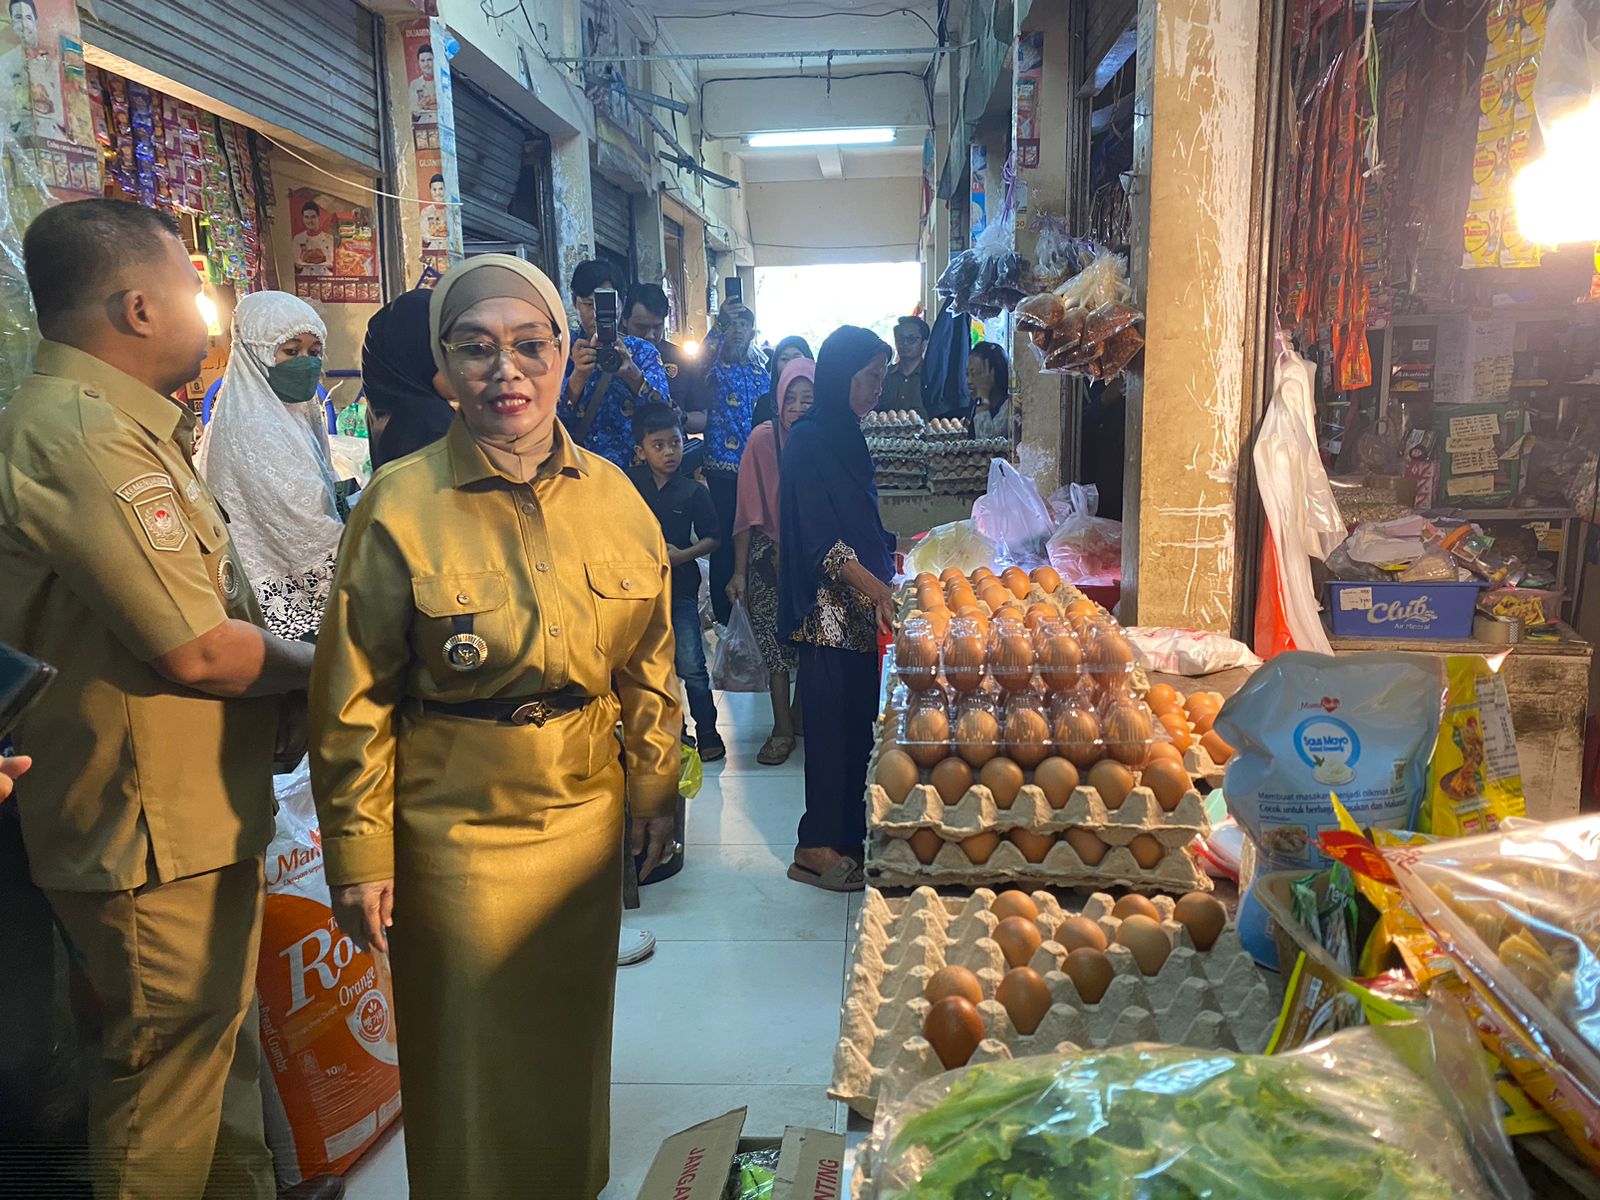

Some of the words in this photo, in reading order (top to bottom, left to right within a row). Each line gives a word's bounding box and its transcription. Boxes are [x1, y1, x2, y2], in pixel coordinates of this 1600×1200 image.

[1366, 595, 1438, 624] Club
[278, 928, 362, 1017] Ro
[338, 965, 376, 1007] Orange
